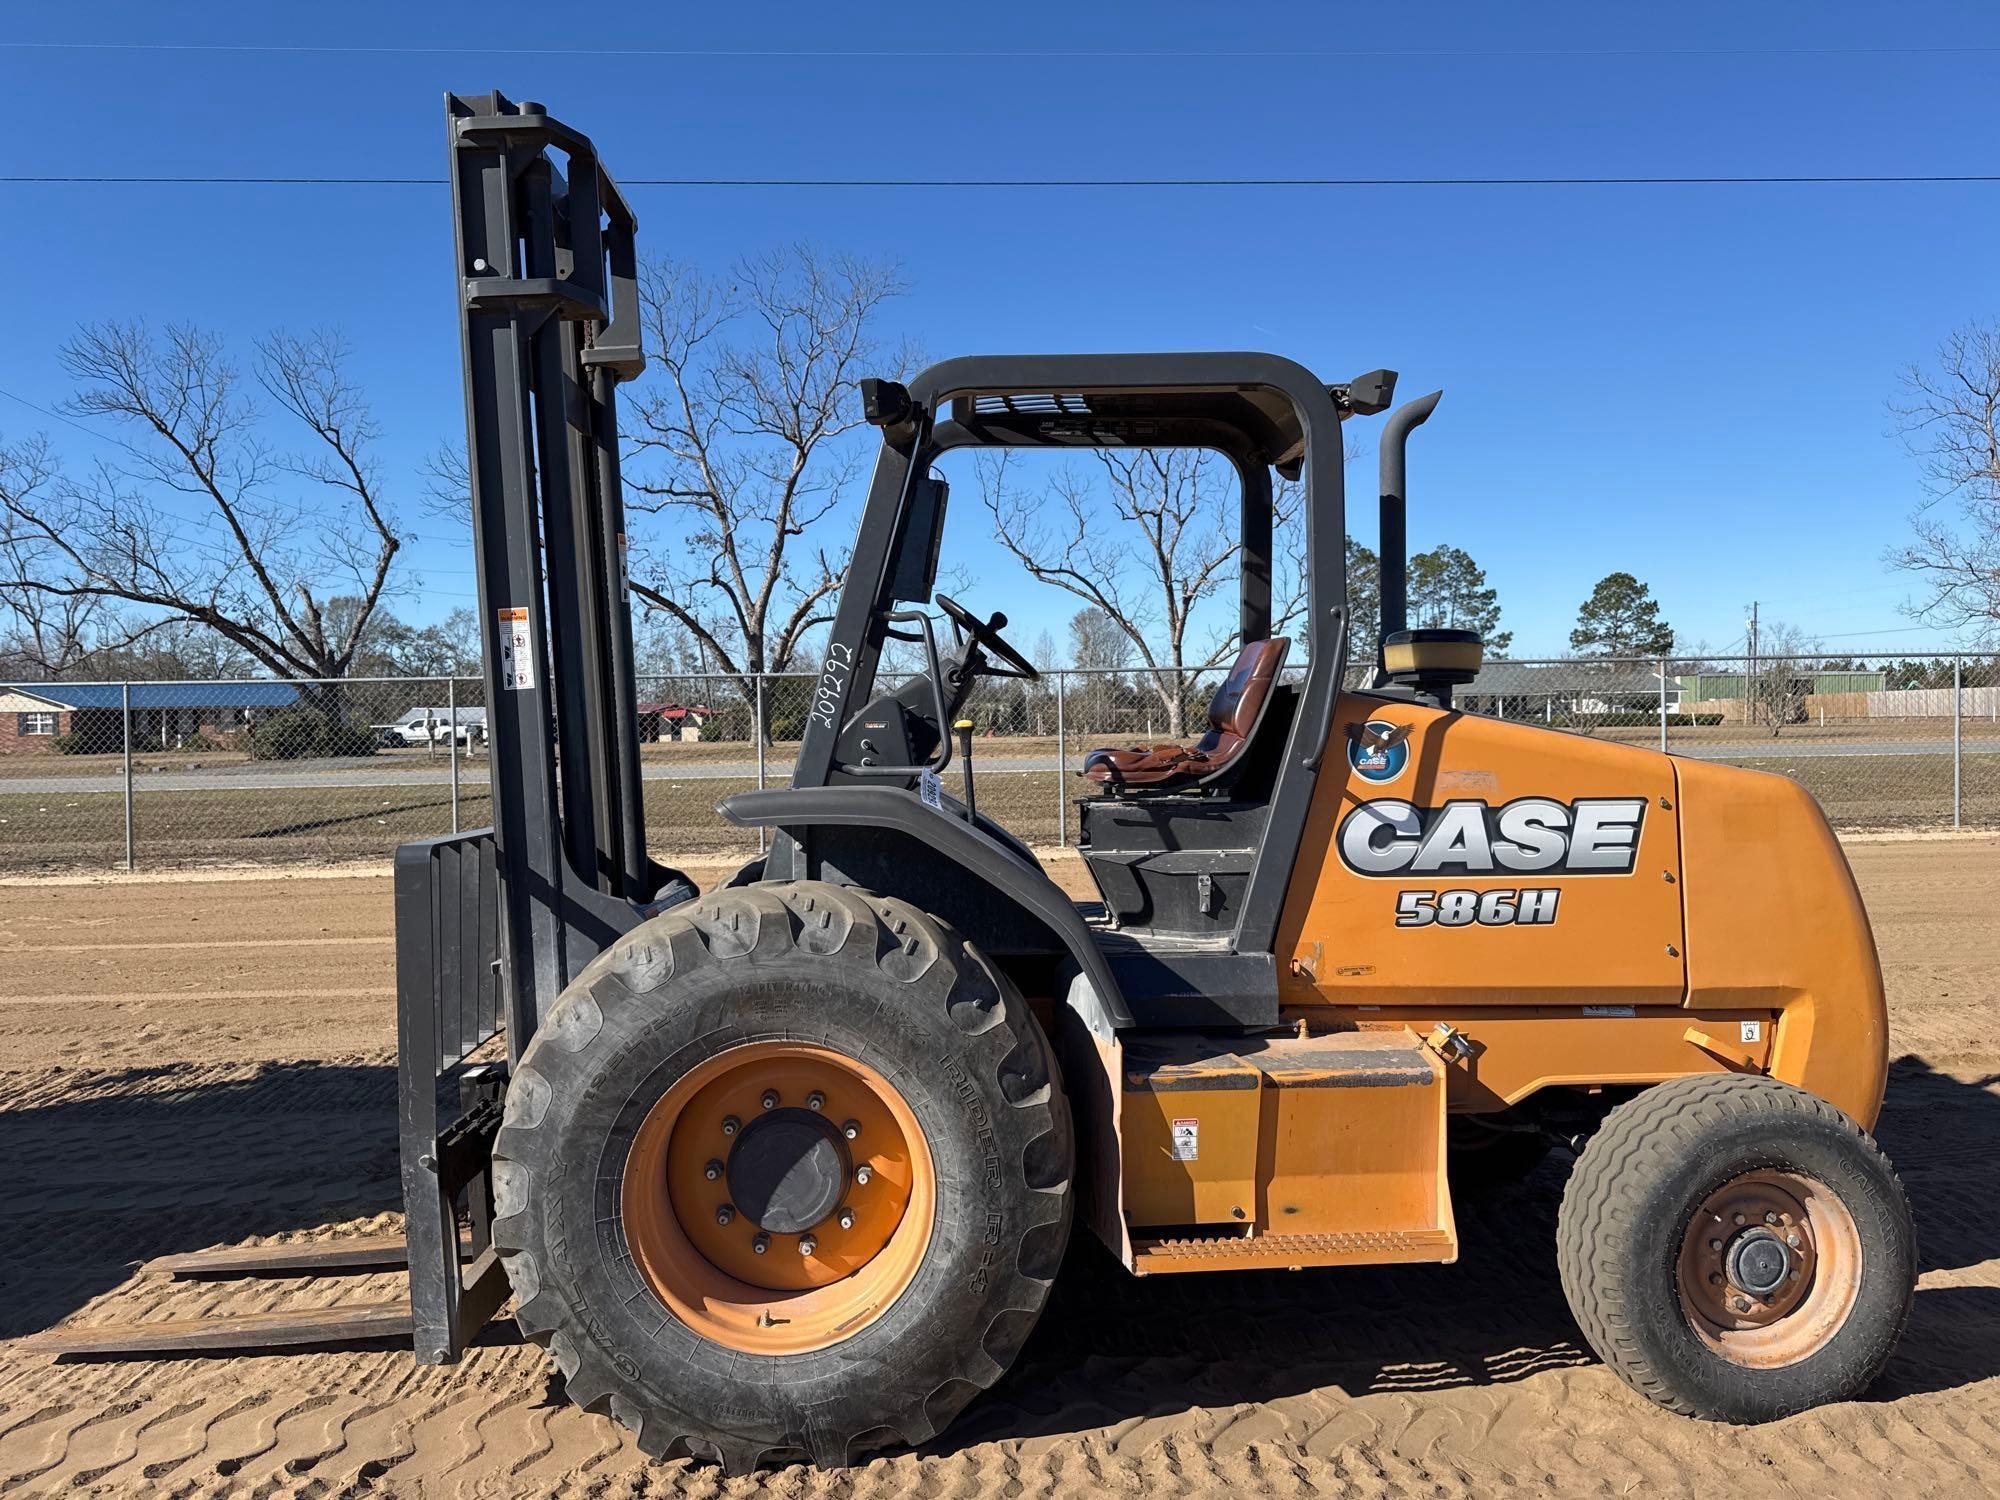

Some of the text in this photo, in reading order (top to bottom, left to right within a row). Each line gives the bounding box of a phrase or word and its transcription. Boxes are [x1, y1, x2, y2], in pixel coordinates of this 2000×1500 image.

[811, 642, 853, 729] 209292
[1359, 757, 1387, 765] CASE
[1338, 799, 1647, 876] CASE
[1395, 889, 1561, 926] 586H
[939, 1054, 1001, 1190] RIDER
[1838, 1158, 1899, 1260] GALAXY
[547, 1148, 642, 1382] GALAXY
[968, 1213, 1002, 1294] R-4
